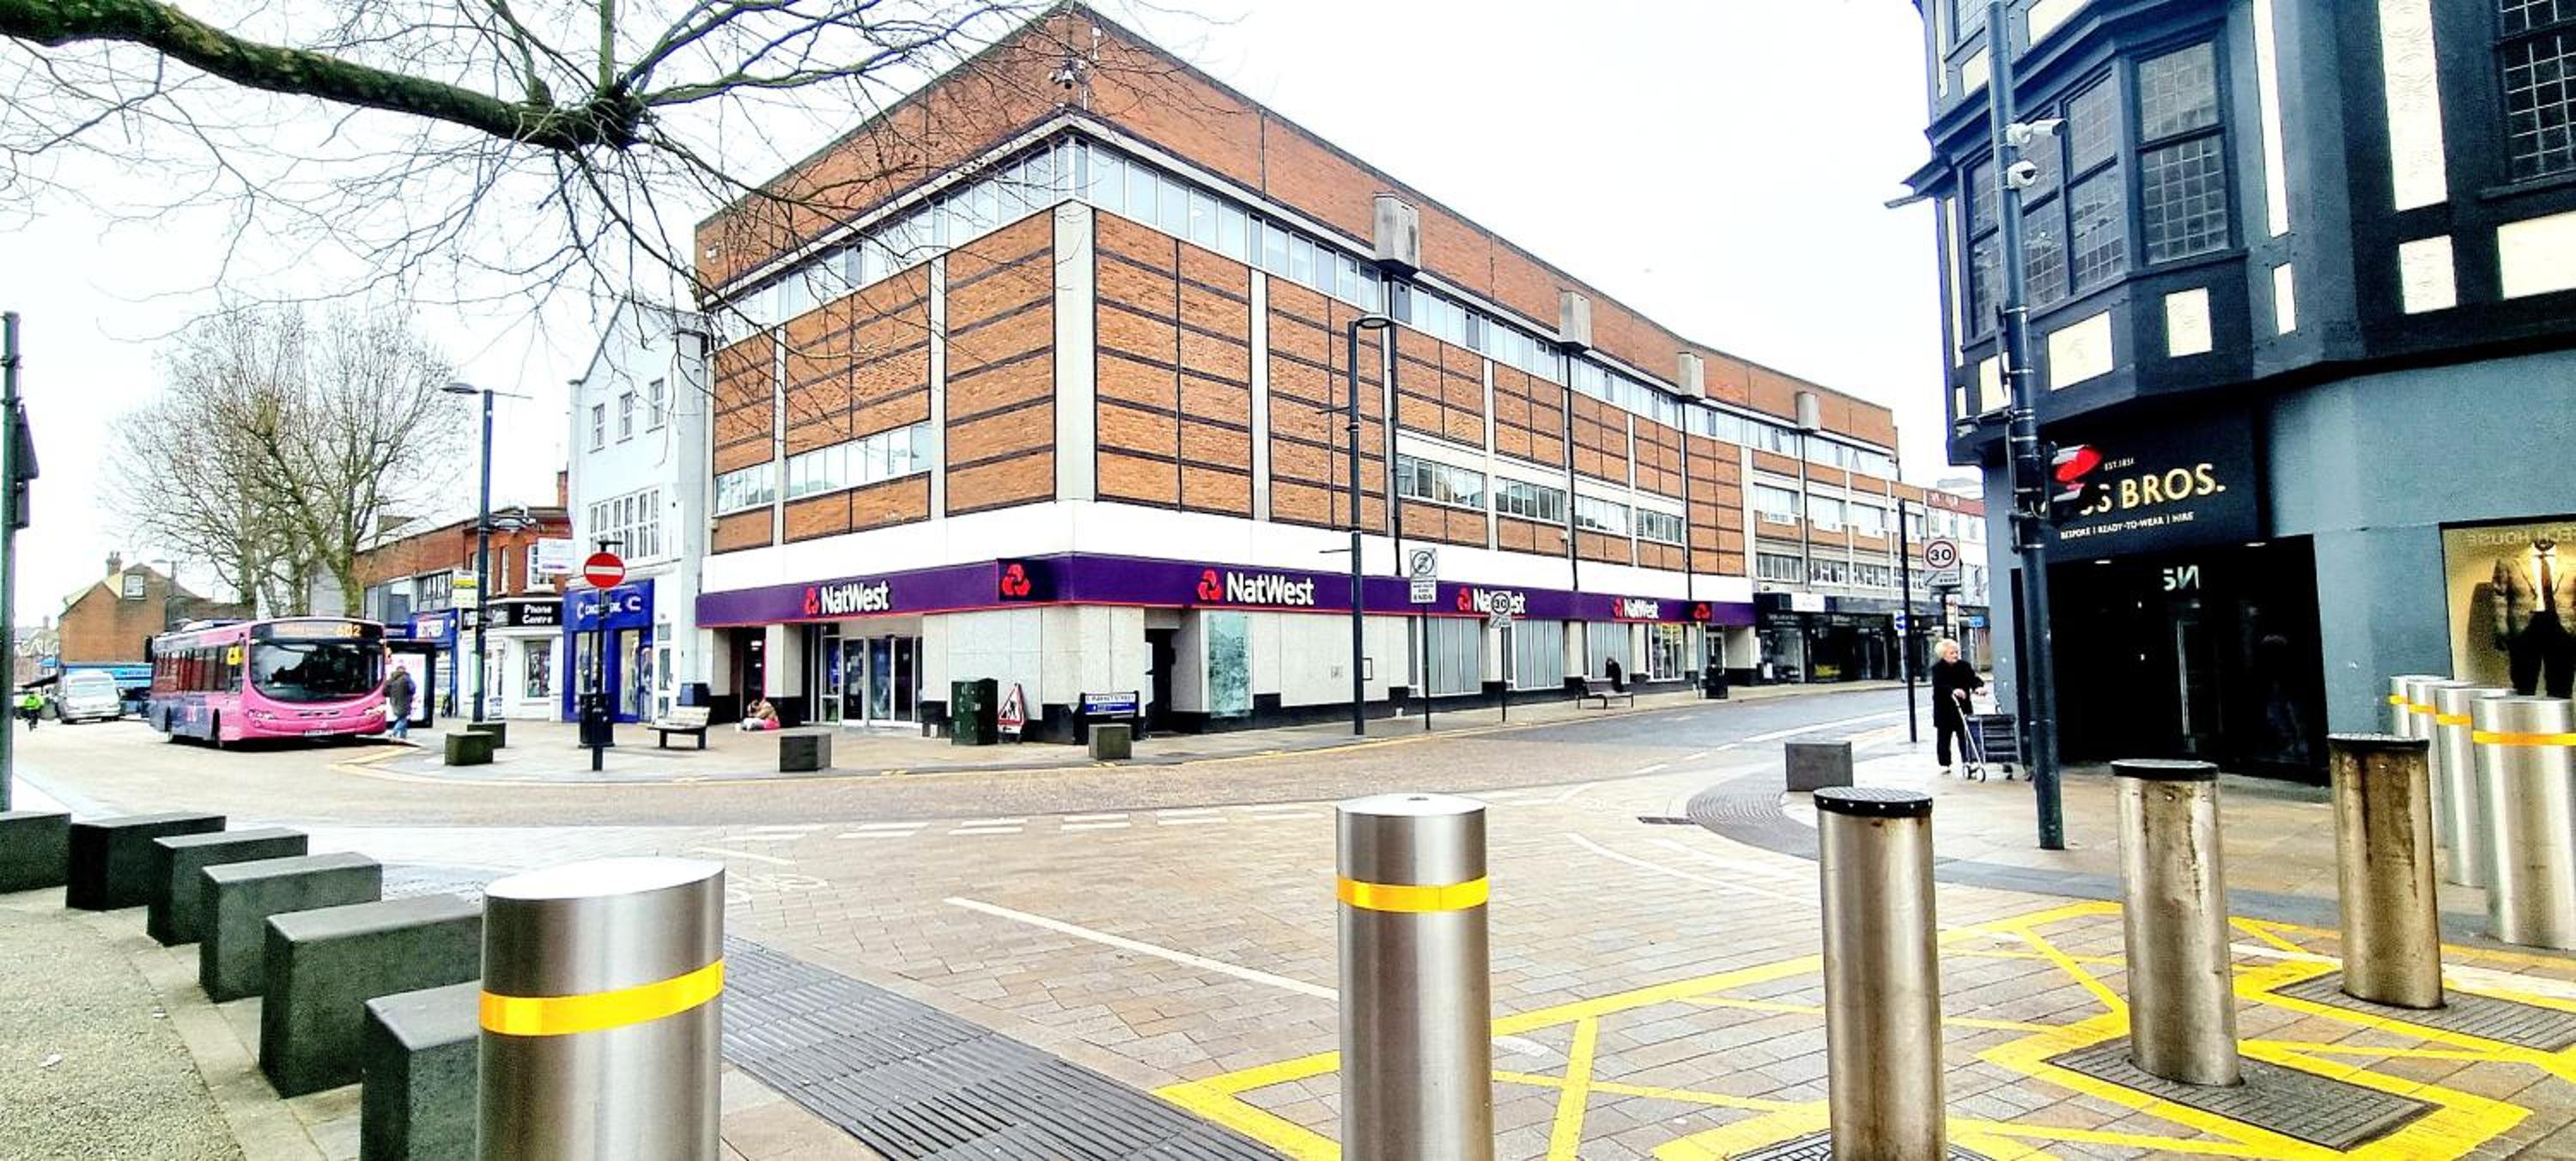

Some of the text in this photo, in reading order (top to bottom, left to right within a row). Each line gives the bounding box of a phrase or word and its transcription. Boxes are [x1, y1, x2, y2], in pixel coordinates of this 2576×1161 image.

[2120, 463, 2227, 509] BROS.
[2061, 526, 2091, 540] BESPOKE
[2172, 511, 2195, 522] HIRE
[1929, 549, 1952, 561] 30
[821, 580, 889, 615] NatWest
[1226, 571, 1315, 605] NatWest
[521, 614, 553, 624] Centre
[523, 604, 552, 614] Phone
[1623, 597, 1660, 619] NatWest
